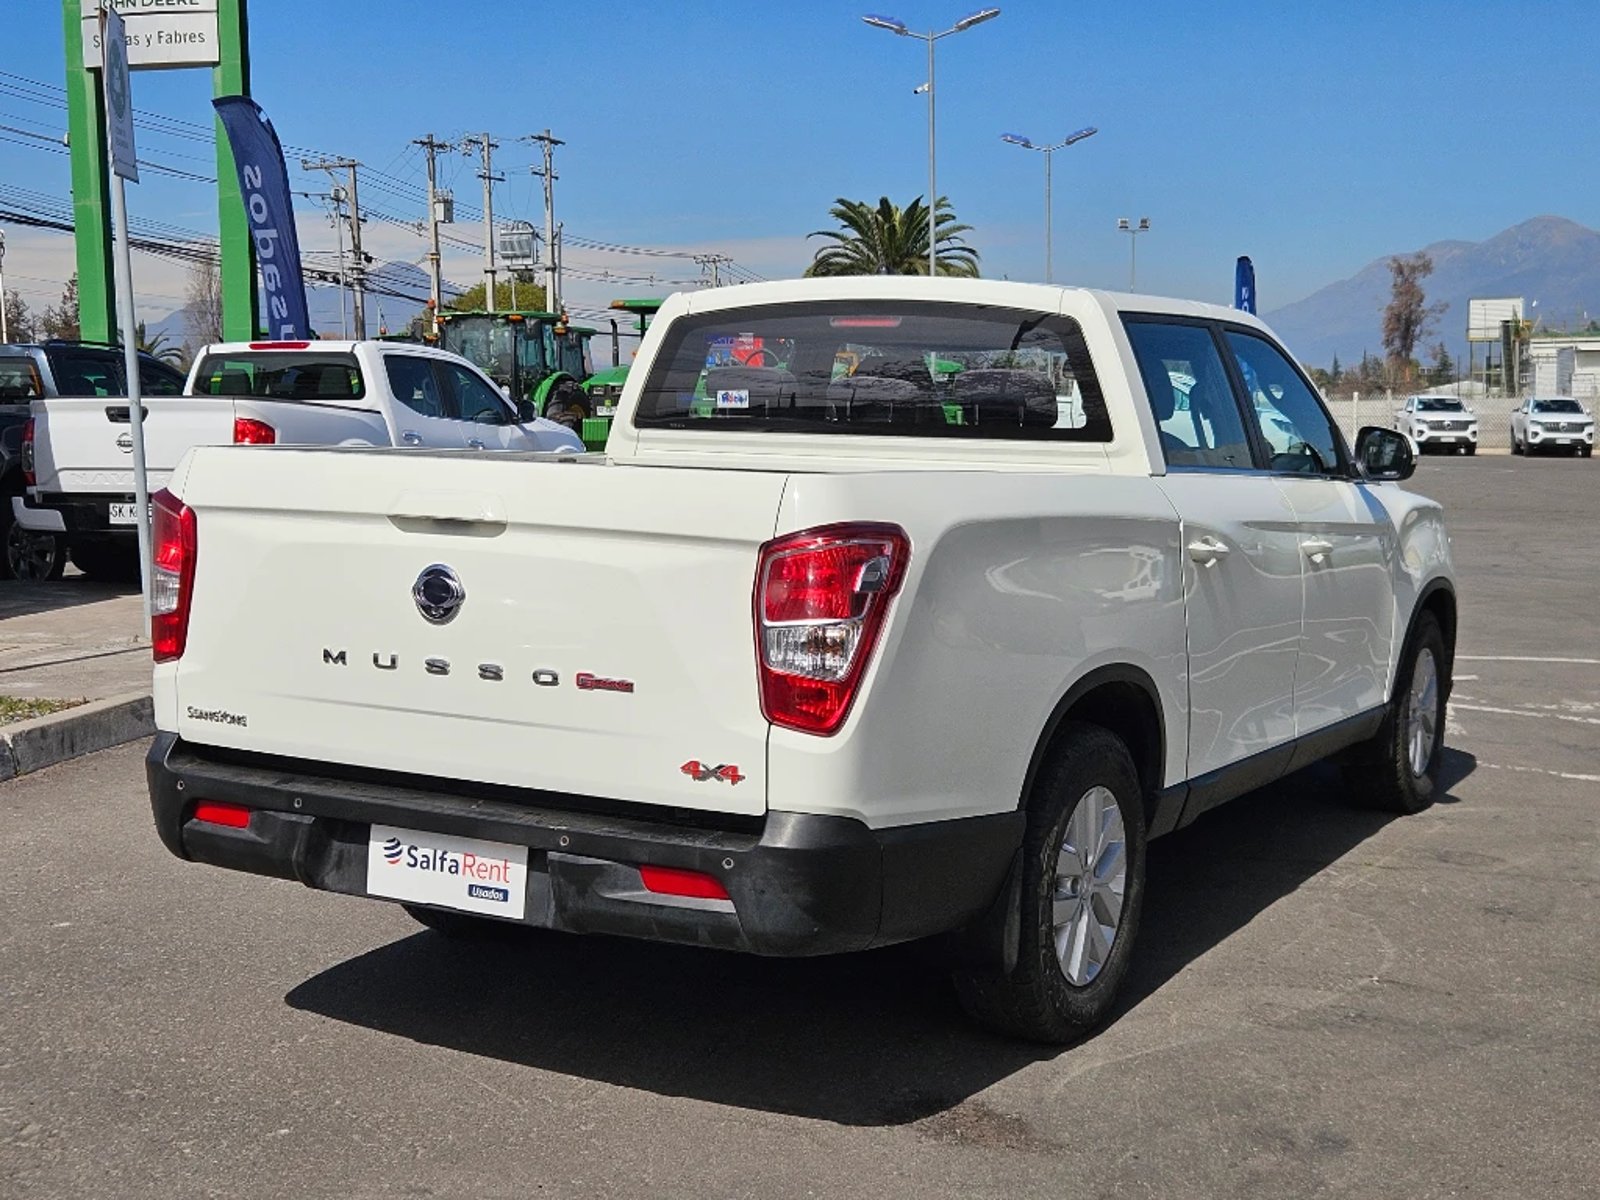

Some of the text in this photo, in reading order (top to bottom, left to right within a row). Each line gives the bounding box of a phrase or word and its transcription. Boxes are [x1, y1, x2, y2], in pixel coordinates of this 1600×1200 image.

[145, 33, 152, 48] y
[157, 30, 206, 45] Fabres
[111, 505, 125, 518] SK
[322, 648, 560, 687] MUSSO
[472, 885, 504, 901] Usados
